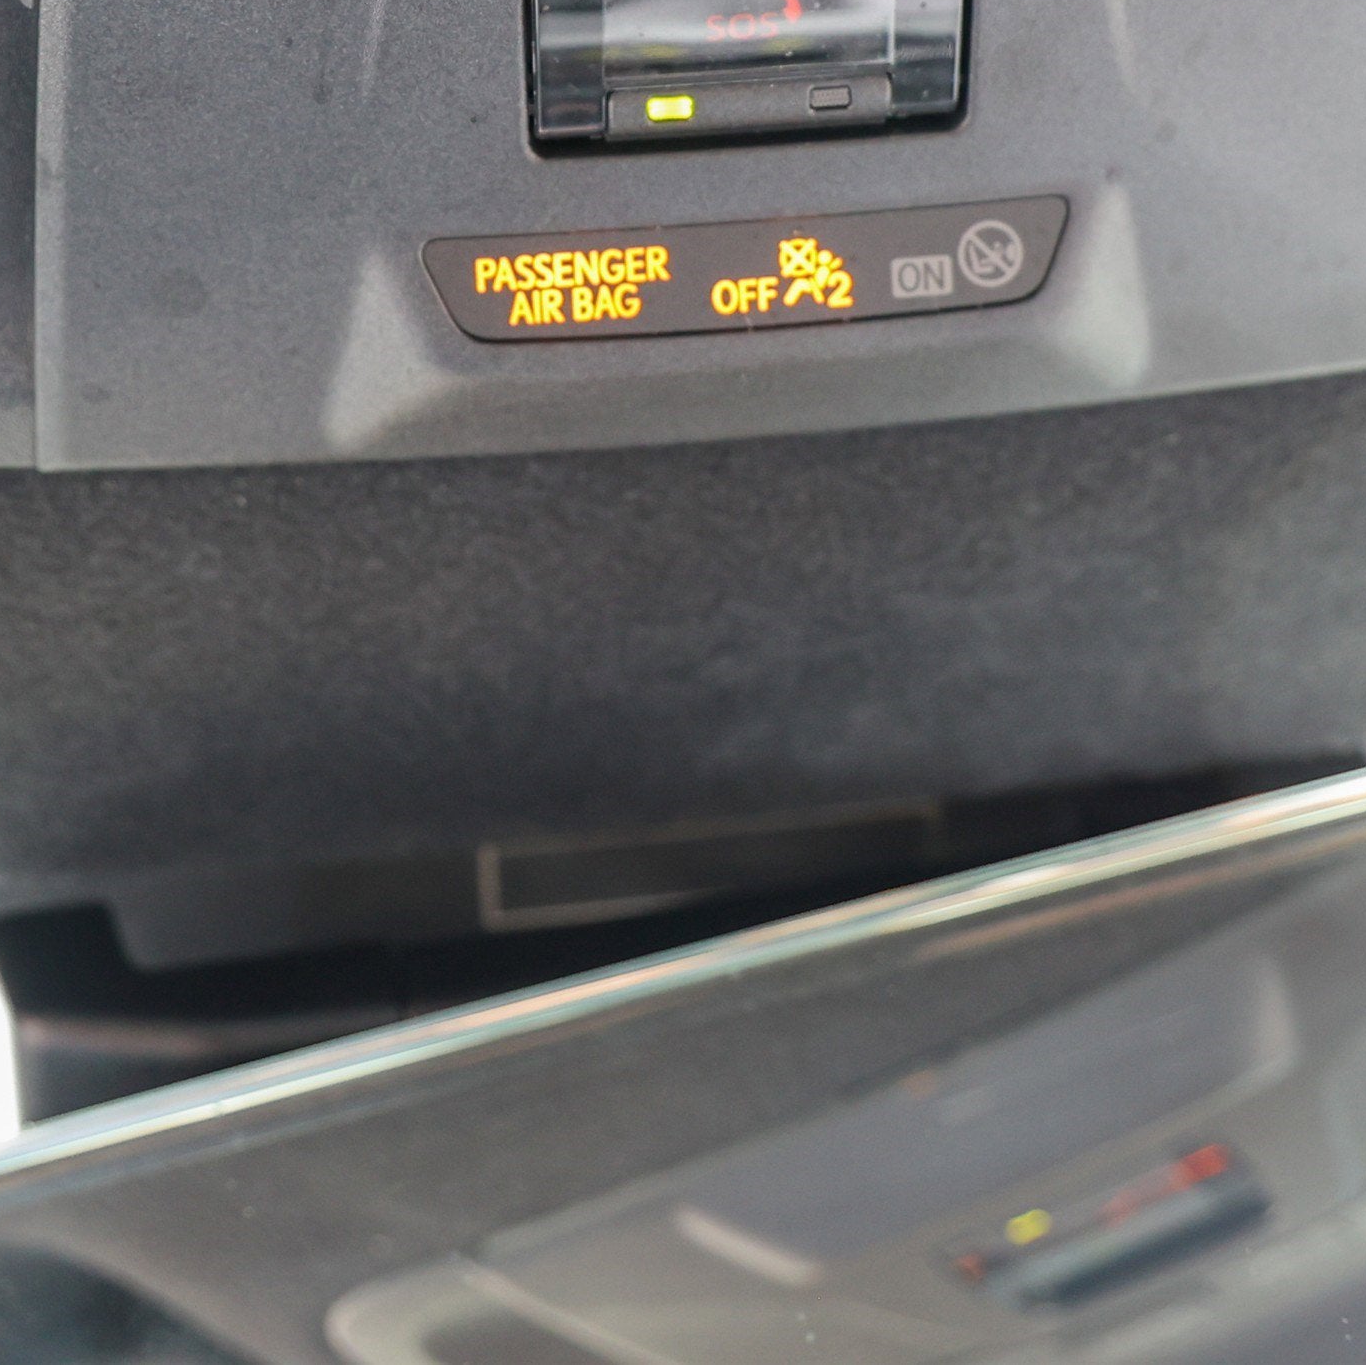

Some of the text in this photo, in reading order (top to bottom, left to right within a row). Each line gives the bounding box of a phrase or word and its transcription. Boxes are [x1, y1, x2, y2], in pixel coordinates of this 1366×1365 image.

[706, 13, 780, 43] SOS
[474, 245, 671, 294] PASSENGER
[898, 261, 945, 291] ON
[508, 284, 642, 326] AIR BAG
[711, 277, 778, 316] OFF
